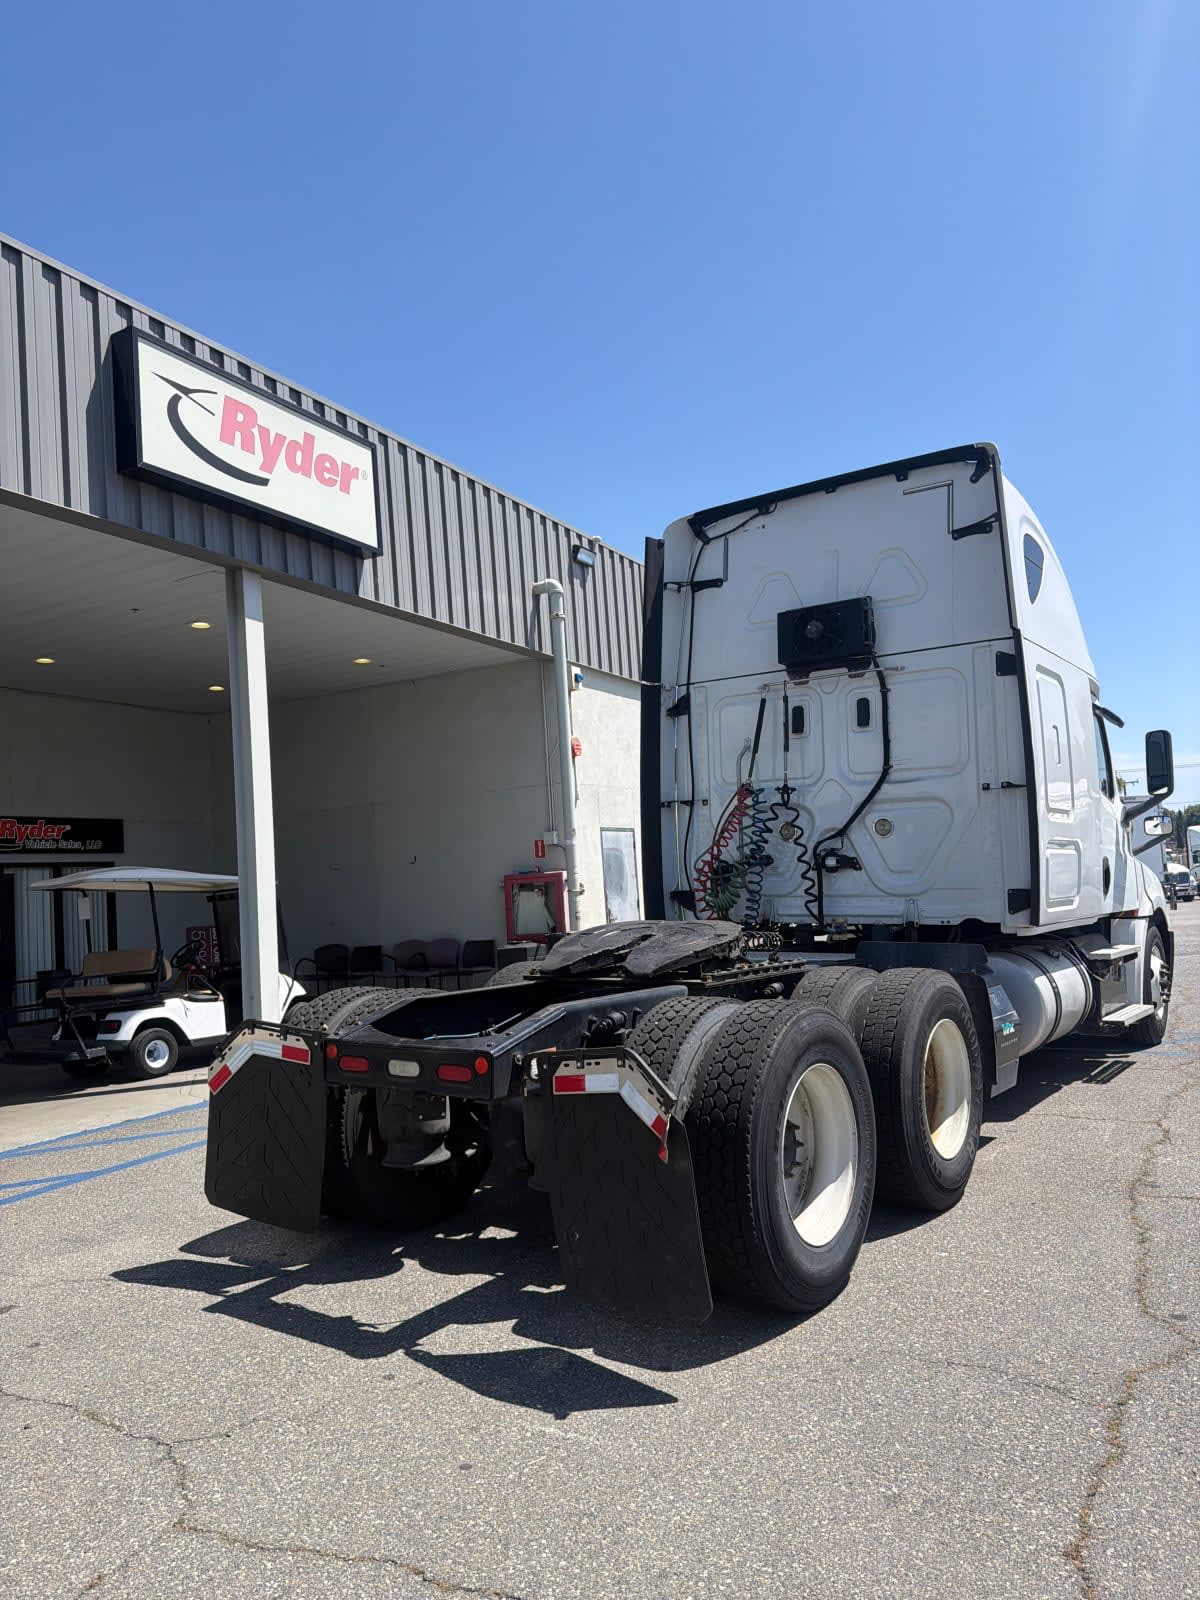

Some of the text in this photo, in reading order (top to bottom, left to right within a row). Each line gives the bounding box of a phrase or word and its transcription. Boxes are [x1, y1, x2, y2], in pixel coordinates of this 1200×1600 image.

[219, 394, 360, 496] Ryder
[0, 819, 66, 844] Ryder
[25, 839, 57, 849] Vehicle
[86, 840, 103, 850] LLC
